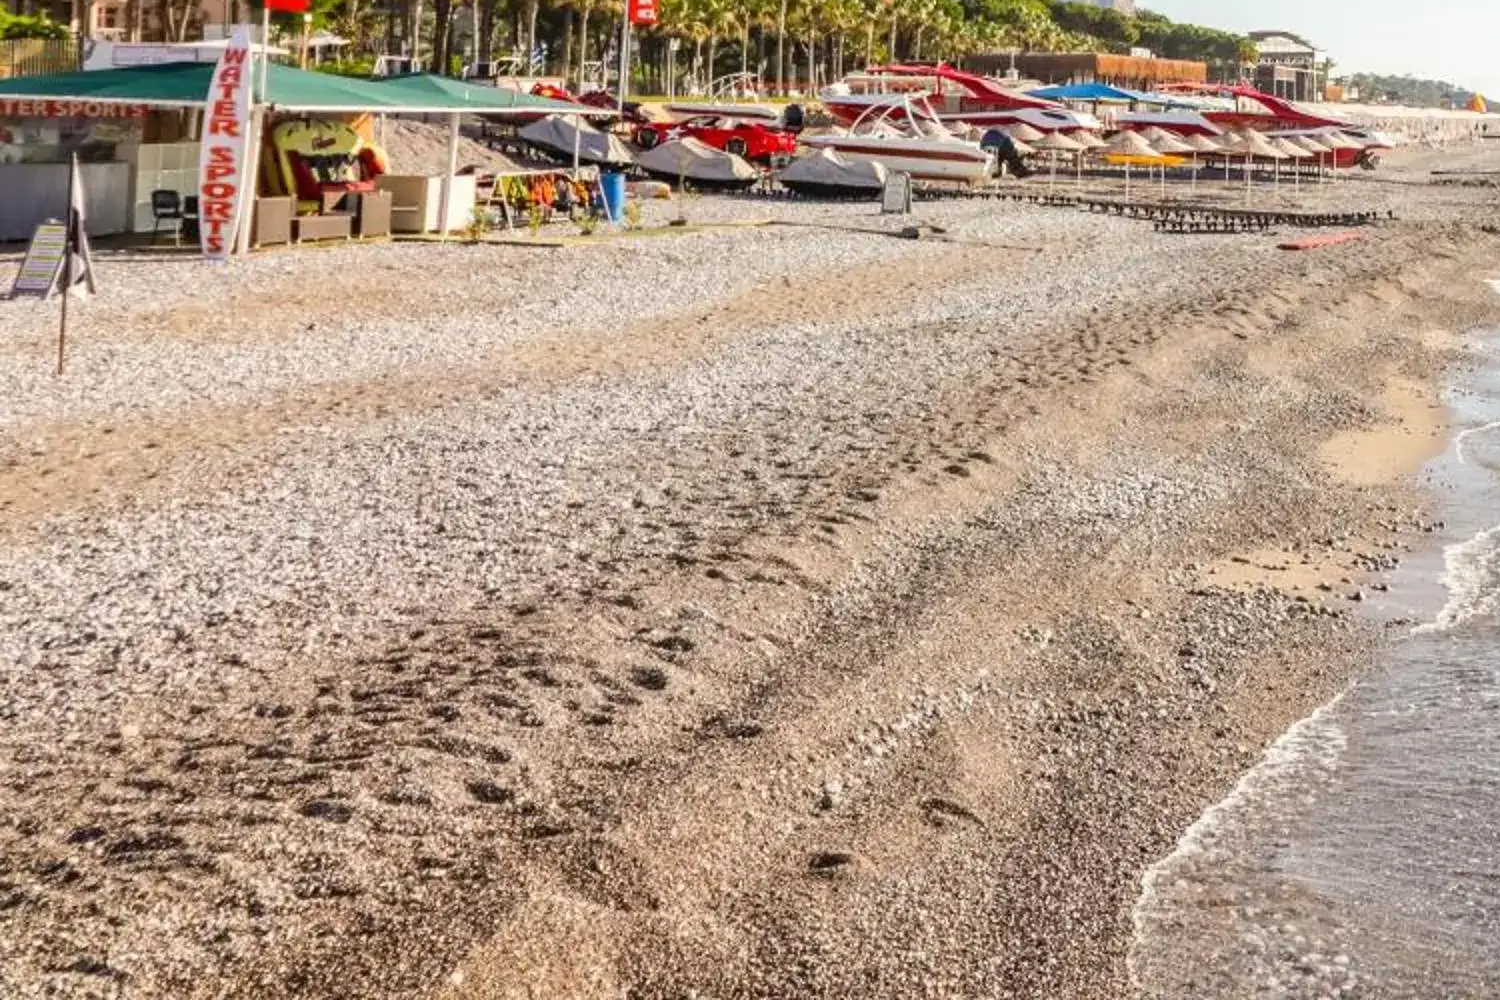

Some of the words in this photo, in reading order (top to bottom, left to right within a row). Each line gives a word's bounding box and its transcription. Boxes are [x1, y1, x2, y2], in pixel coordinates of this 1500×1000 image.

[53, 101, 143, 117] SPORTS
[210, 49, 248, 137] WATER
[202, 147, 235, 253] SPORTS
